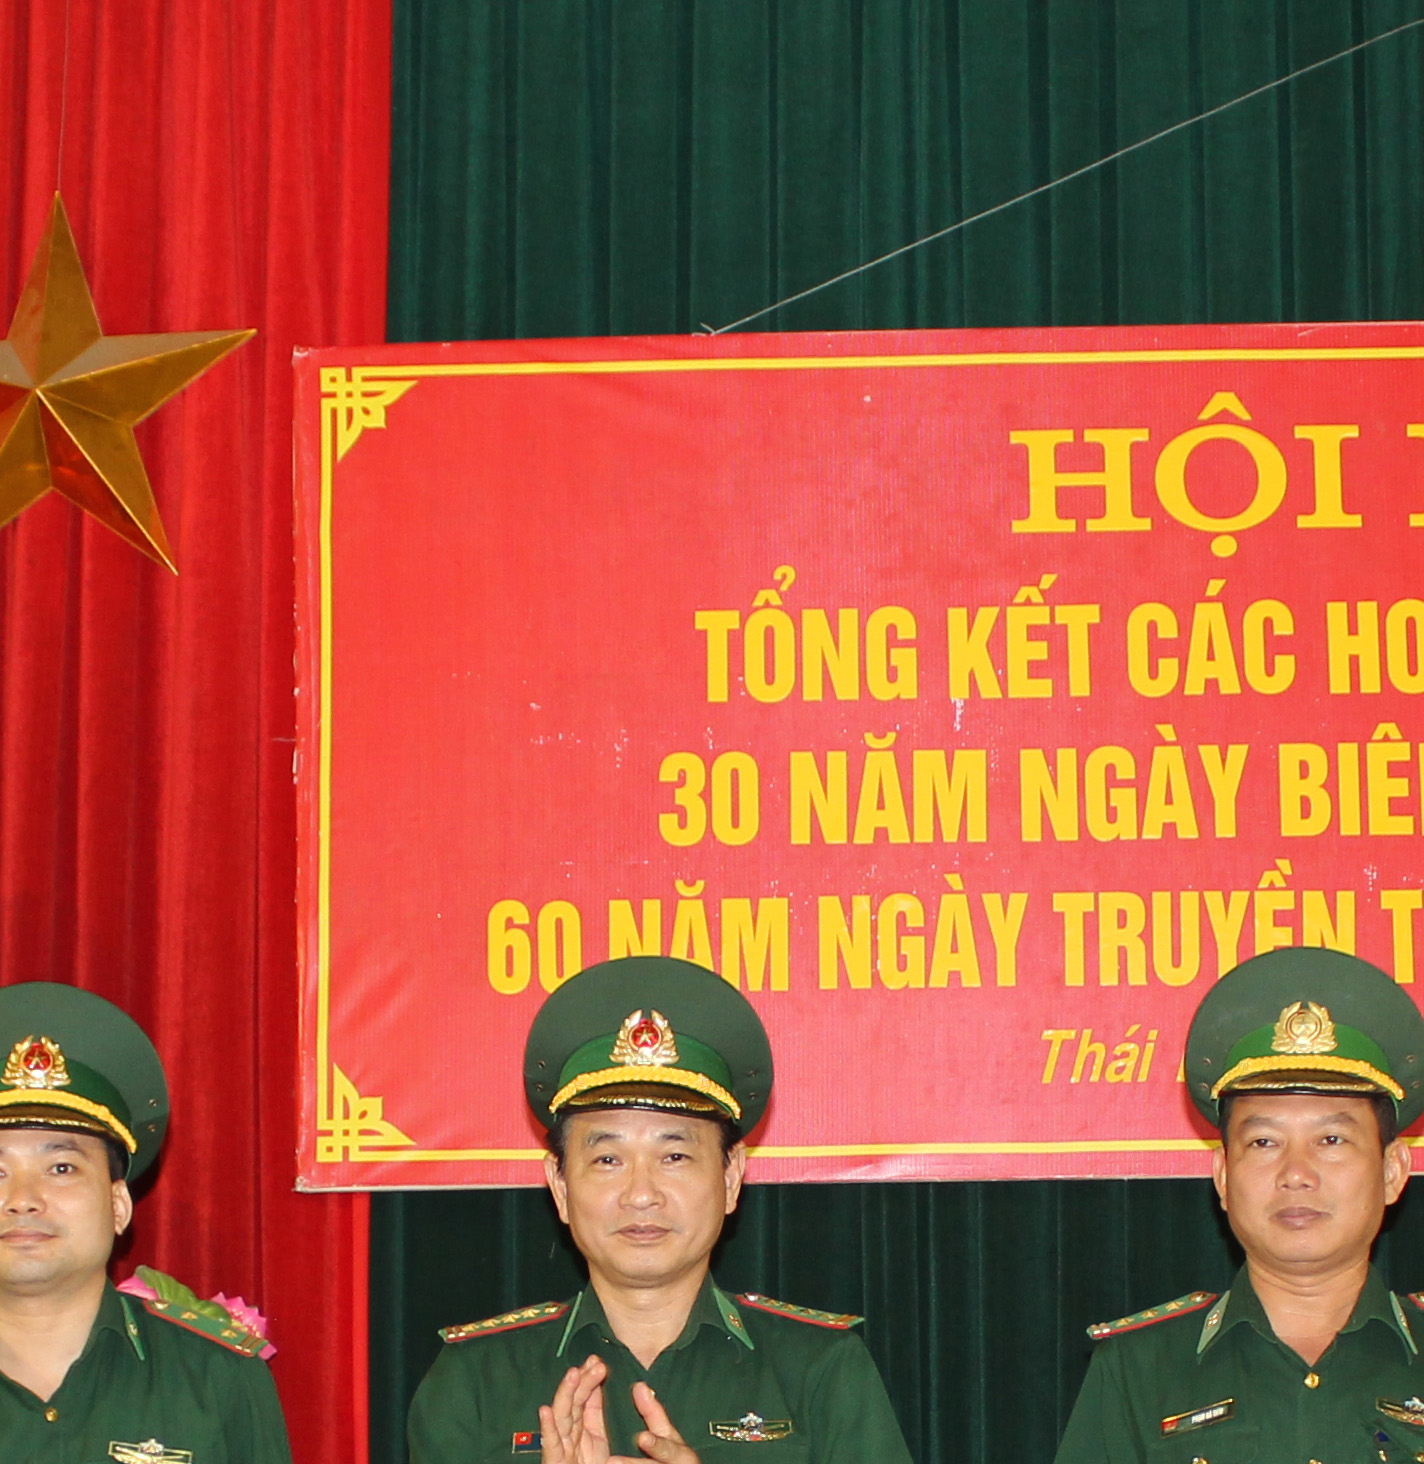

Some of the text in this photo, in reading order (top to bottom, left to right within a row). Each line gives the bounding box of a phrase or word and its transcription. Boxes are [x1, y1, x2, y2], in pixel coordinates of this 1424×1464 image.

[1009, 391, 1364, 559] HỘI
[694, 565, 919, 704] TỔNG
[946, 573, 1102, 700] KẾT
[1126, 578, 1297, 698] CÁC
[658, 750, 761, 848] 30
[789, 731, 989, 846] NĂM
[1019, 723, 1250, 843] NGÀY
[486, 899, 584, 996] 60
[607, 879, 791, 993] NĂM
[817, 872, 1029, 990] NGÀY
[1051, 858, 1357, 988] TRUYỀN
[1041, 1024, 1159, 1084] Thái
